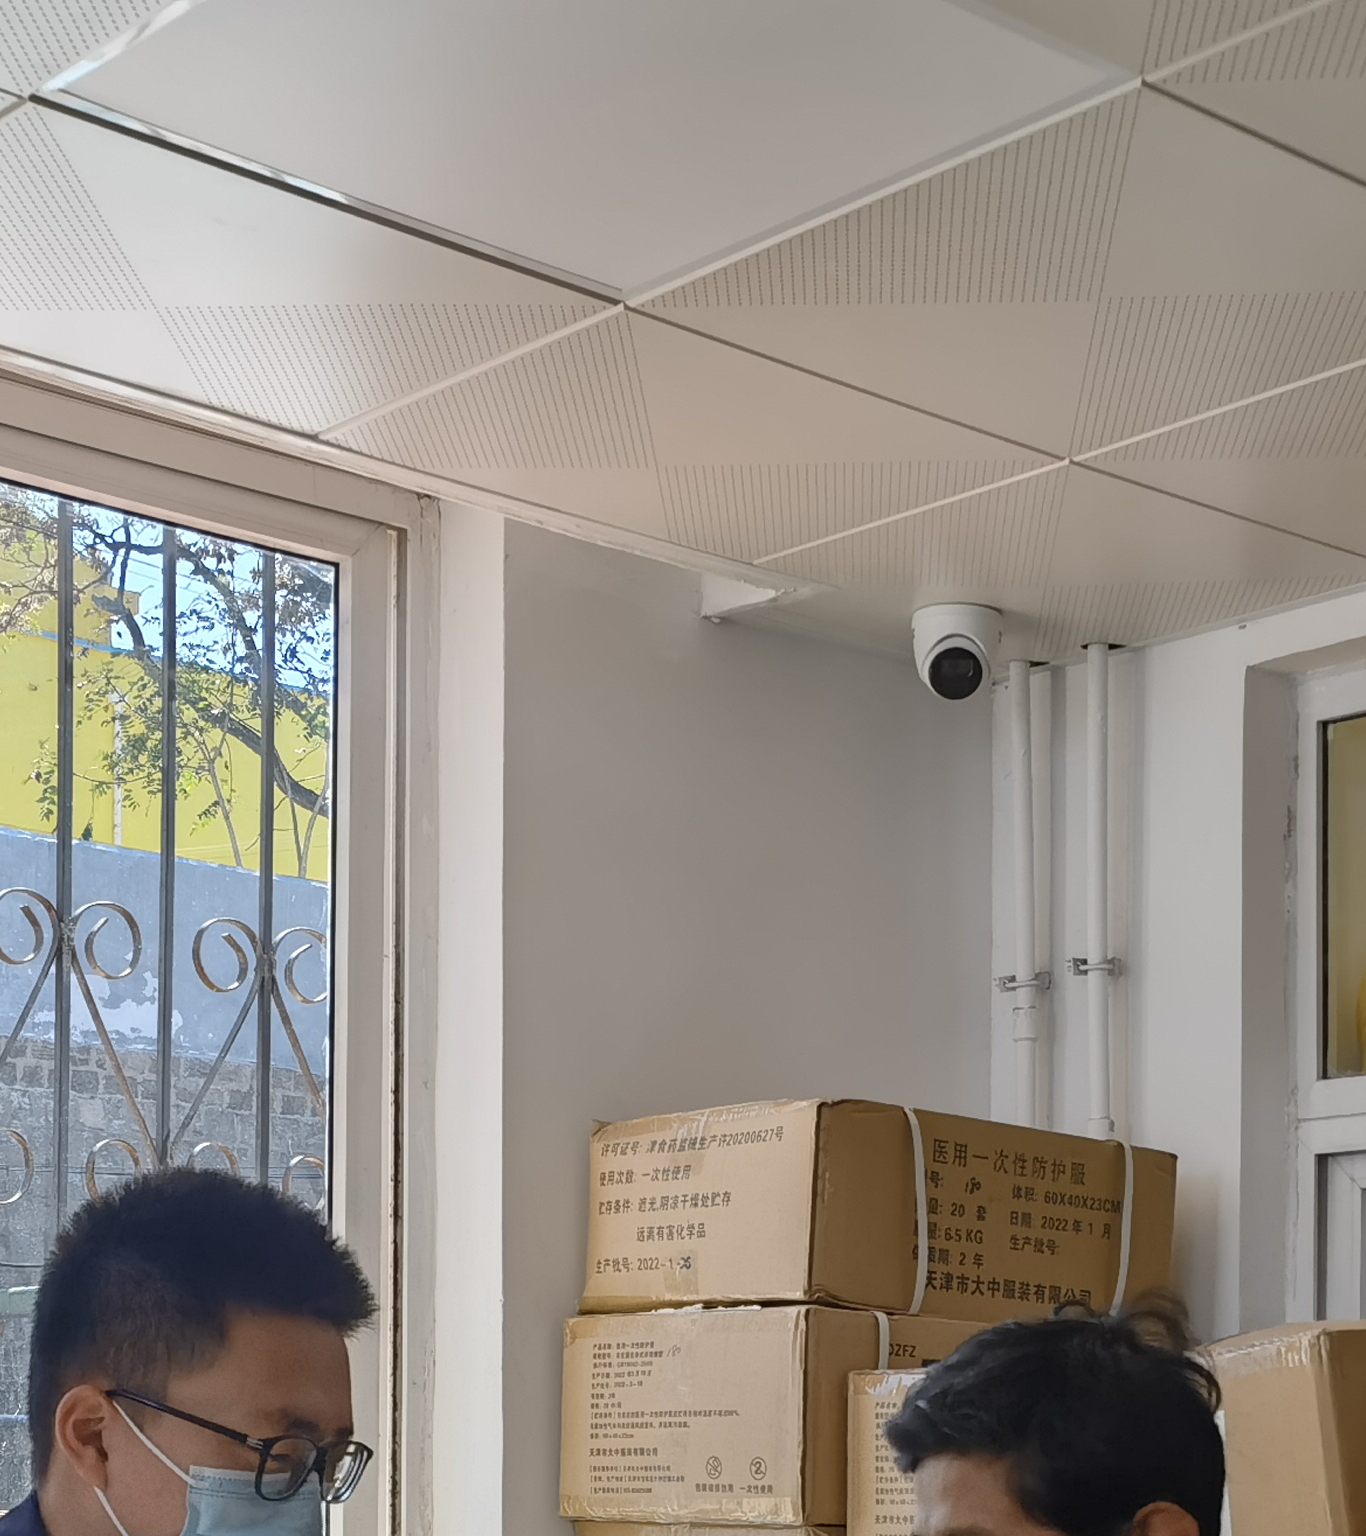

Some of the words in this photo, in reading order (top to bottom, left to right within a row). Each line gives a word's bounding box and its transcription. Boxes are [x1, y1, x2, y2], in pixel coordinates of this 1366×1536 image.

[932, 1138, 1086, 1187] 医用一次性防护服
[950, 1202, 966, 1218] 20
[925, 1269, 1091, 1304] 天津市大中服装有限公司
